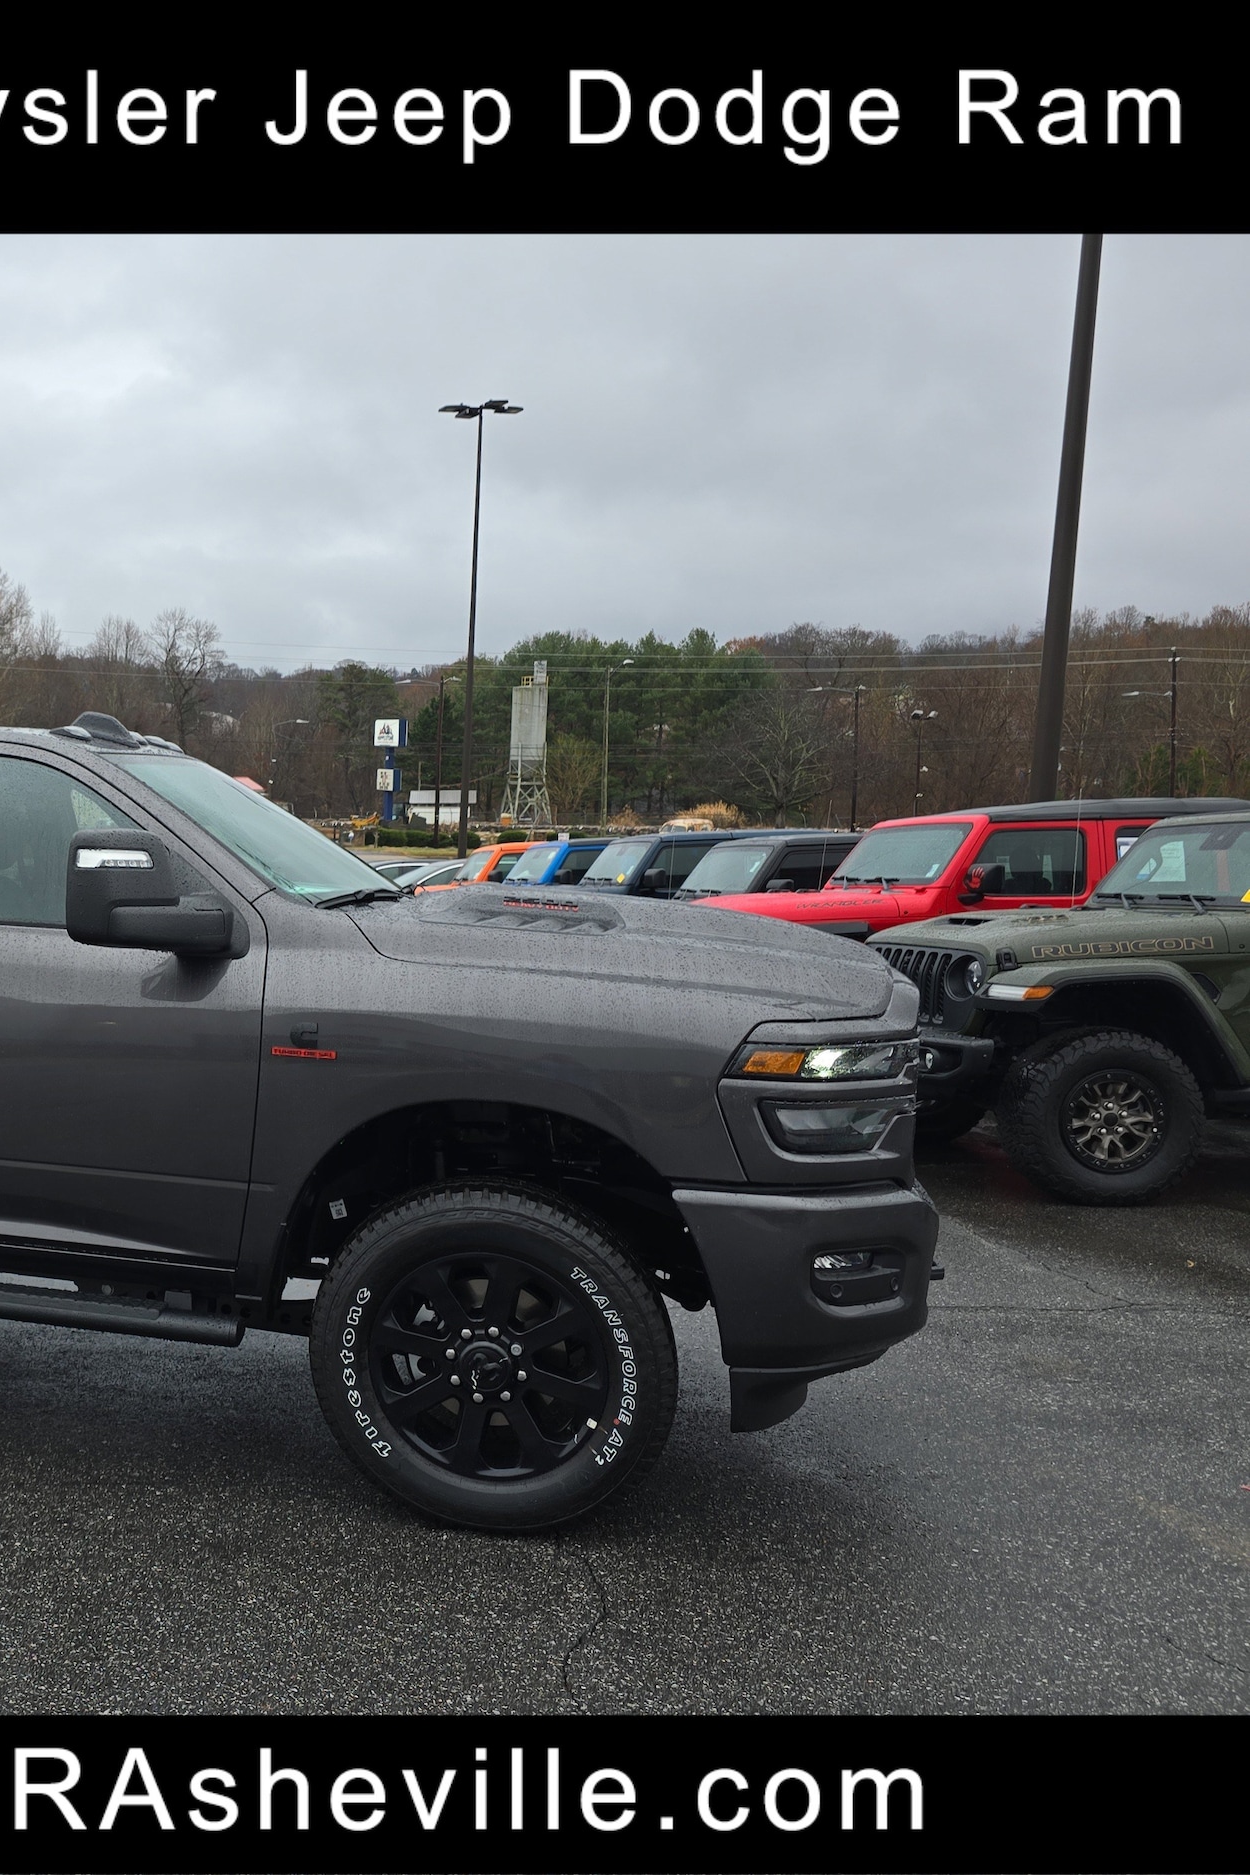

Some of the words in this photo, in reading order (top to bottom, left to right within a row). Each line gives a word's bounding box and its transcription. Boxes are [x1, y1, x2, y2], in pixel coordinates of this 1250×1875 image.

[1031, 936, 1214, 959] RUBICON
[340, 1287, 394, 1459] Firestone
[570, 1266, 637, 1426] TRANSFORCE
